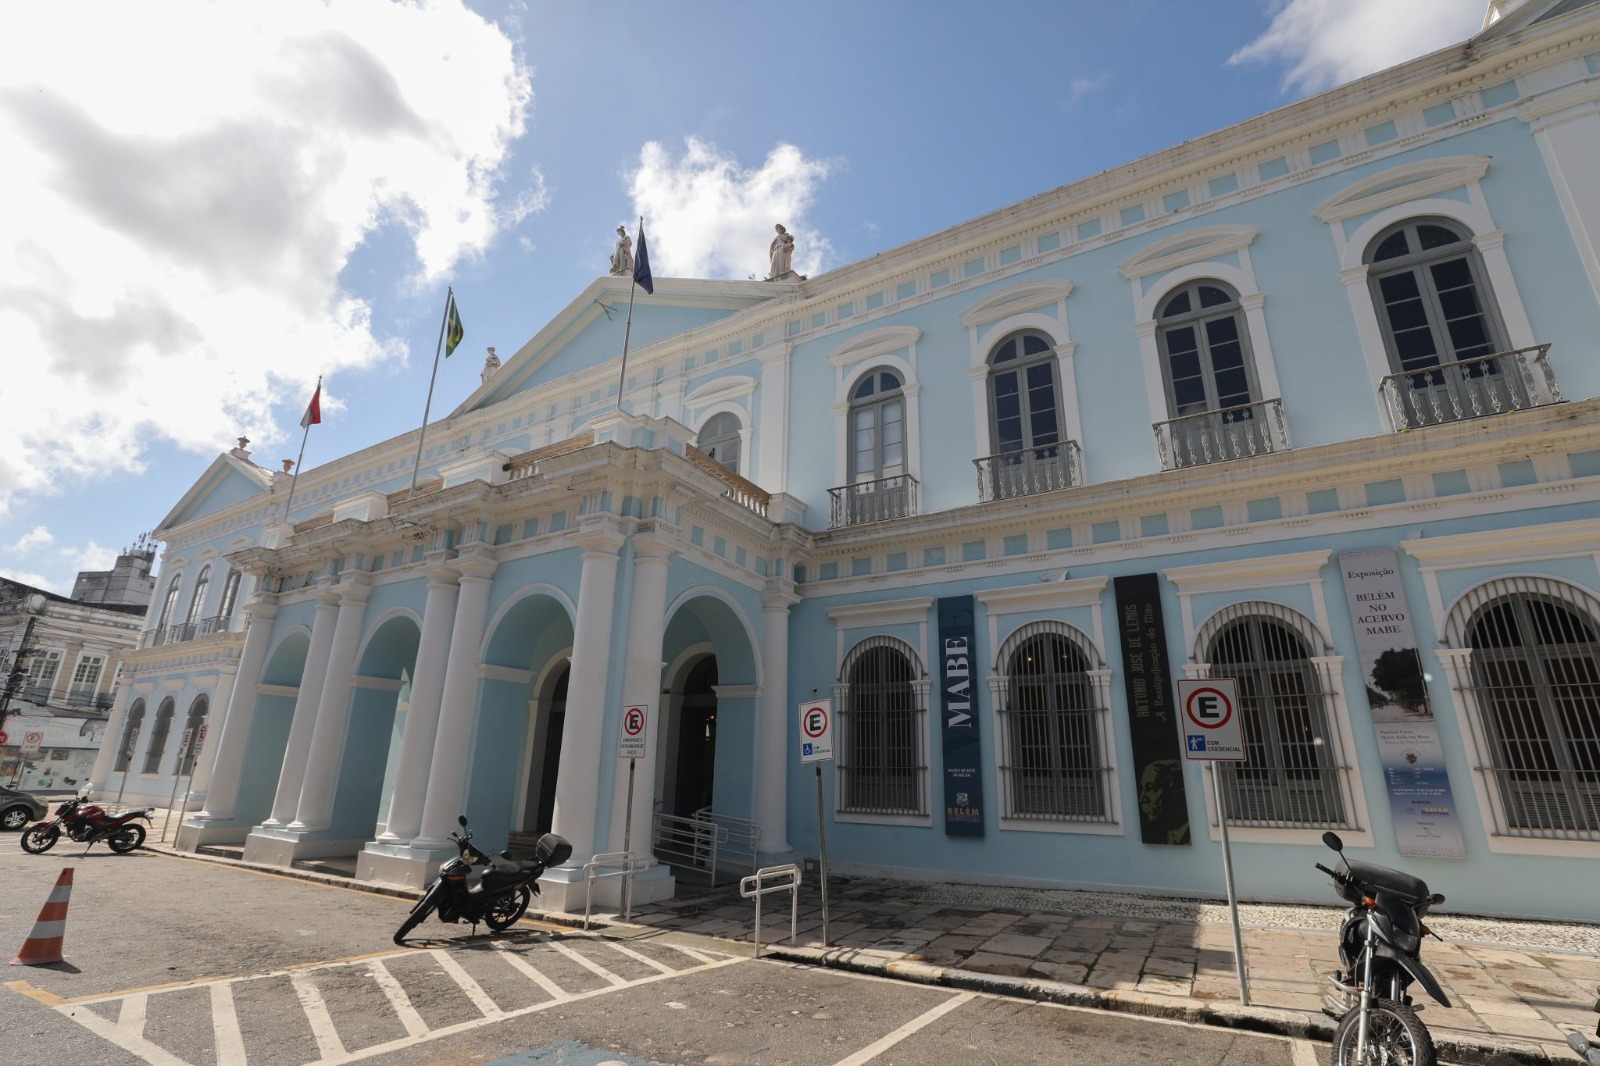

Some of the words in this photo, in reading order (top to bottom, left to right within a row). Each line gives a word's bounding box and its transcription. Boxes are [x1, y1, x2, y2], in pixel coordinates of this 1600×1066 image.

[1348, 568, 1394, 579] Exposição
[1356, 590, 1395, 602] BELÉM
[1368, 604, 1386, 612] NO
[1124, 604, 1140, 632] LEMOS
[1358, 613, 1404, 624] ACERVO
[1146, 627, 1156, 639] do
[1366, 626, 1401, 635] MABE
[1128, 636, 1142, 648] DE
[946, 636, 972, 728] MABE
[1134, 678, 1150, 718] ANTONIO
[1198, 697, 1220, 718] E
[630, 714, 639, 730] E
[810, 714, 821, 732] E
